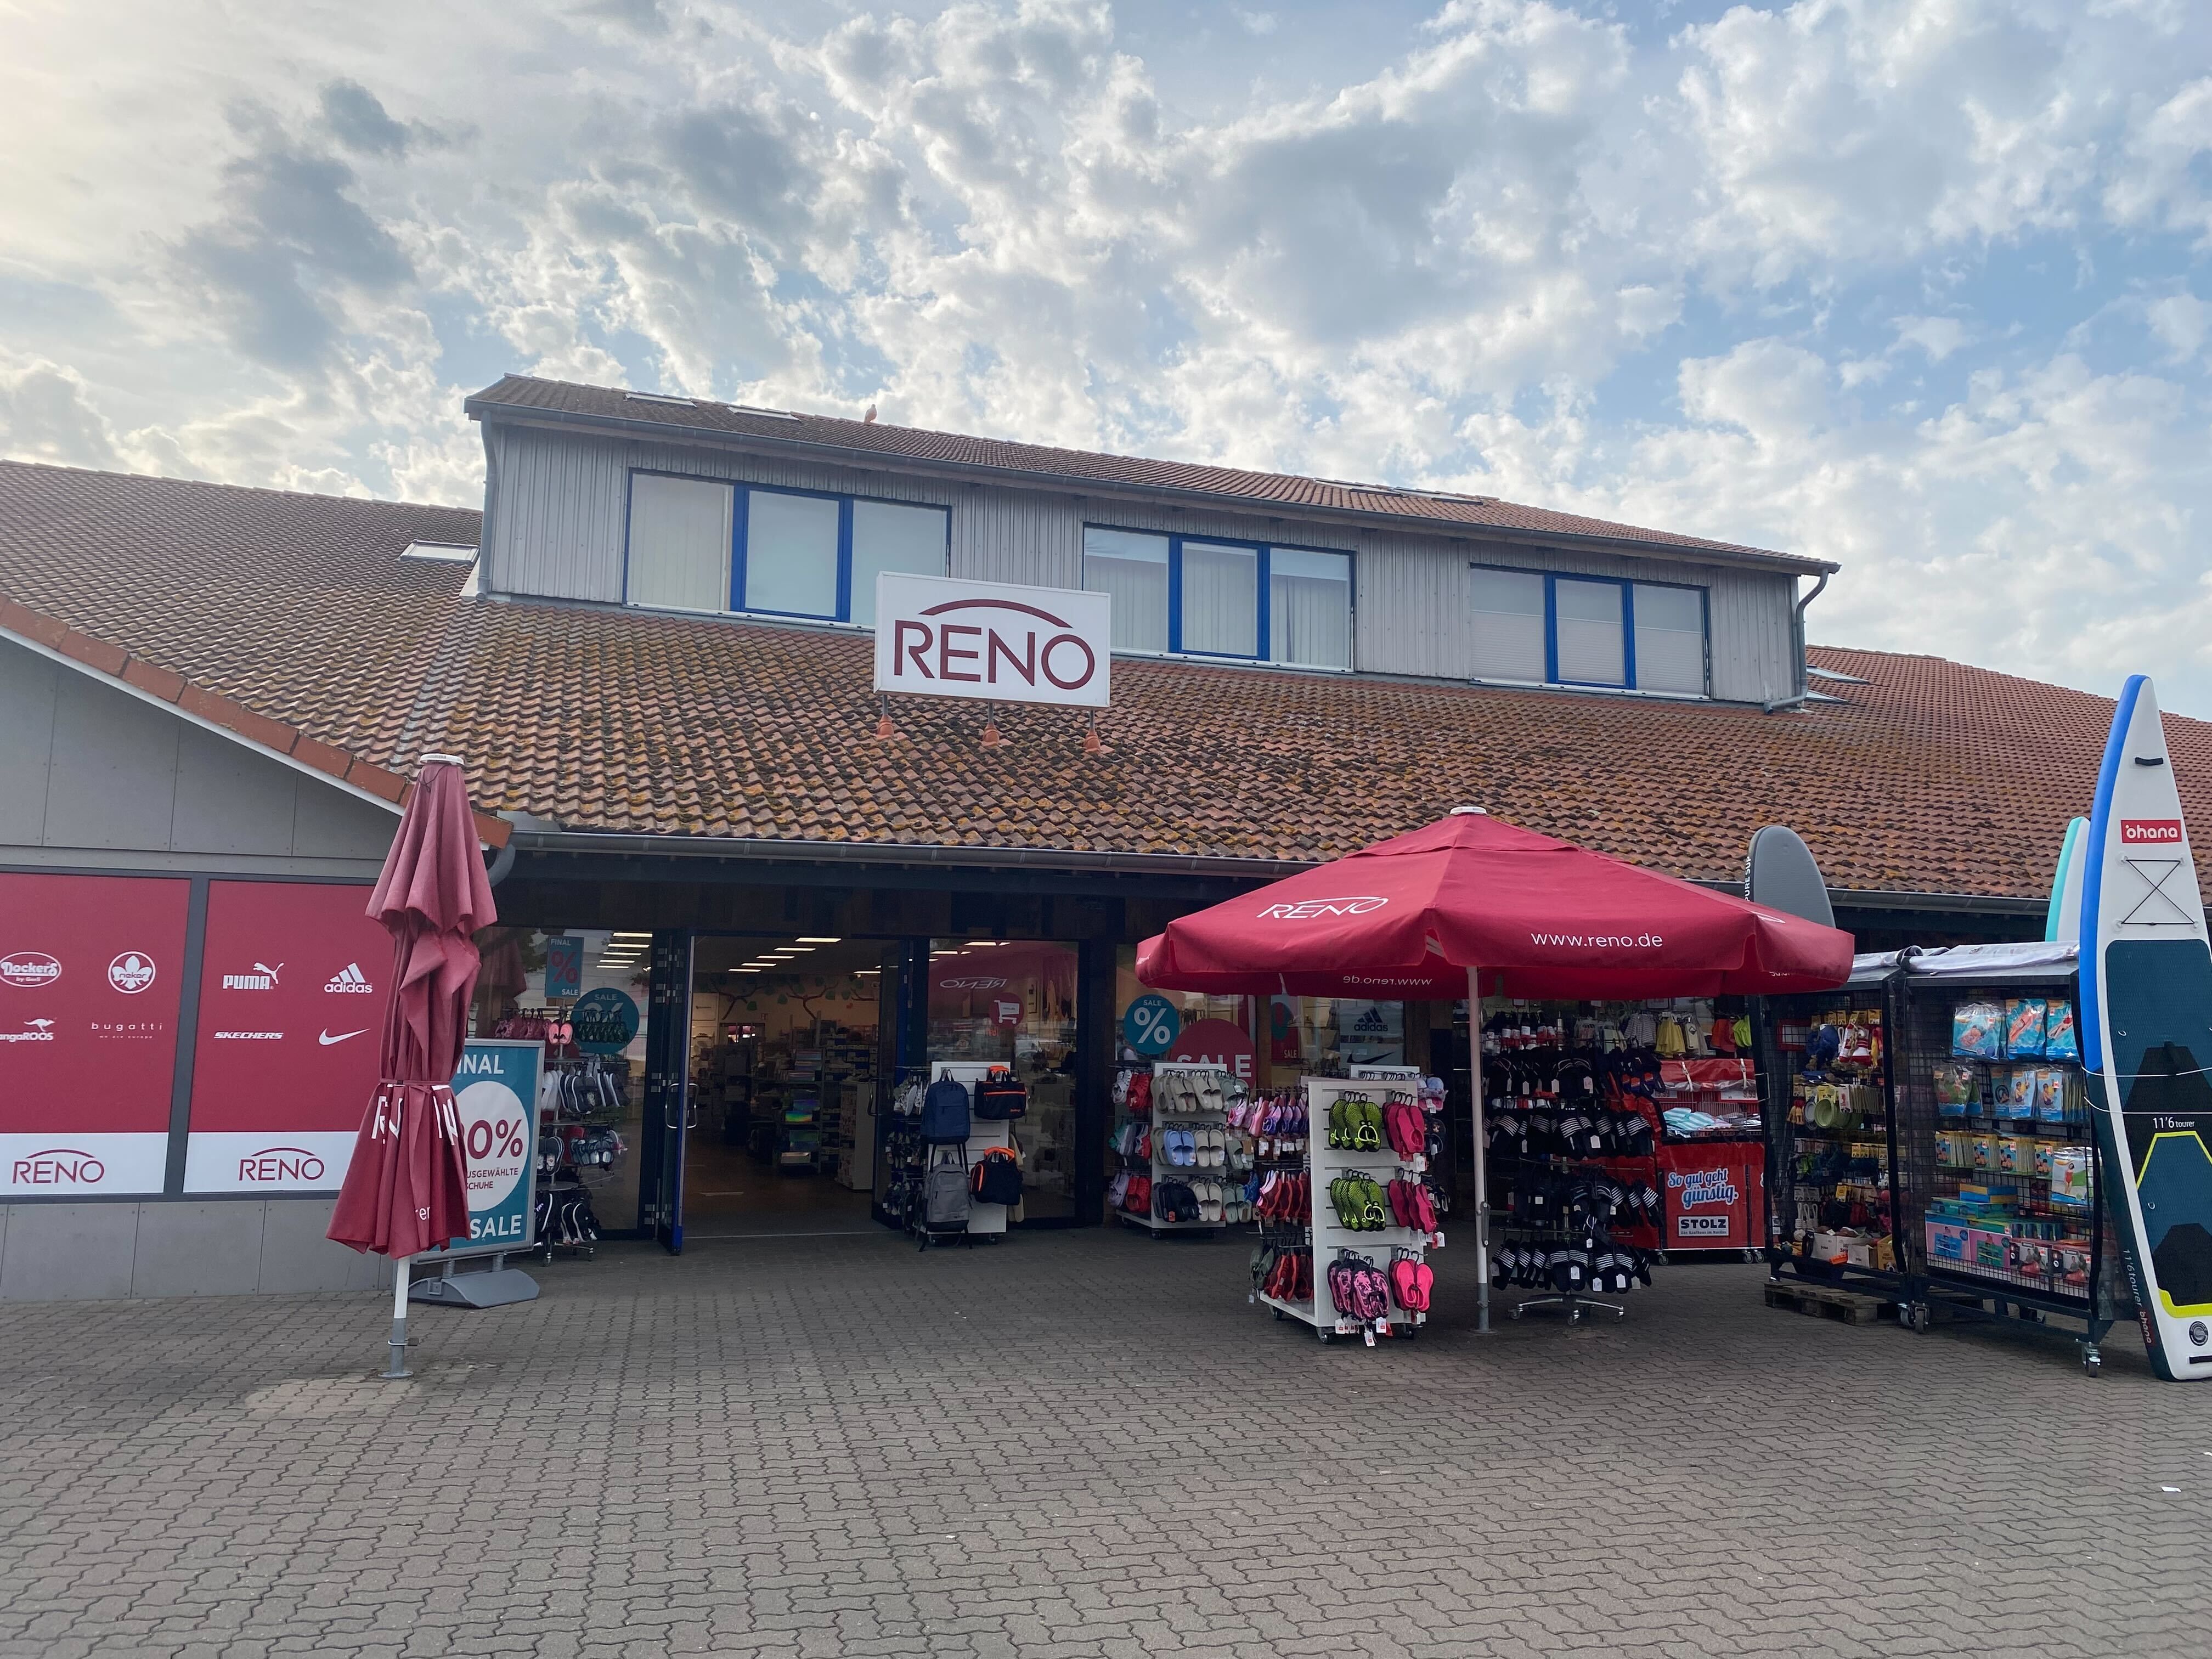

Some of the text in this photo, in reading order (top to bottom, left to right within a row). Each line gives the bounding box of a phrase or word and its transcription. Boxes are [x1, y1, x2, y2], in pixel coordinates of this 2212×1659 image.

[894, 620, 1095, 690] RENO
[1256, 898, 1389, 918] RENO
[1531, 933, 1663, 947] www.reno.de
[222, 975, 270, 989] PUMA
[324, 982, 373, 993] adidas
[91, 1022, 162, 1031] bugatti
[1134, 1007, 1170, 1045] %
[1354, 1022, 1388, 1032] adidas
[0, 1032, 53, 1042] angaROOS
[1284, 1049, 1297, 1058] SALE
[456, 1054, 504, 1074] INAL
[2153, 1116, 2174, 1129] 11'6
[462, 1119, 523, 1159] 0%
[13, 1160, 104, 1183] RENO
[239, 1158, 325, 1181] RENO
[467, 1167, 518, 1178] USGEWÄHLTE
[1668, 1169, 1728, 1189] So gut geht
[1683, 1184, 1738, 1209] günstig.
[470, 1214, 522, 1239] SALE
[1680, 1219, 1726, 1229] STOLZ
